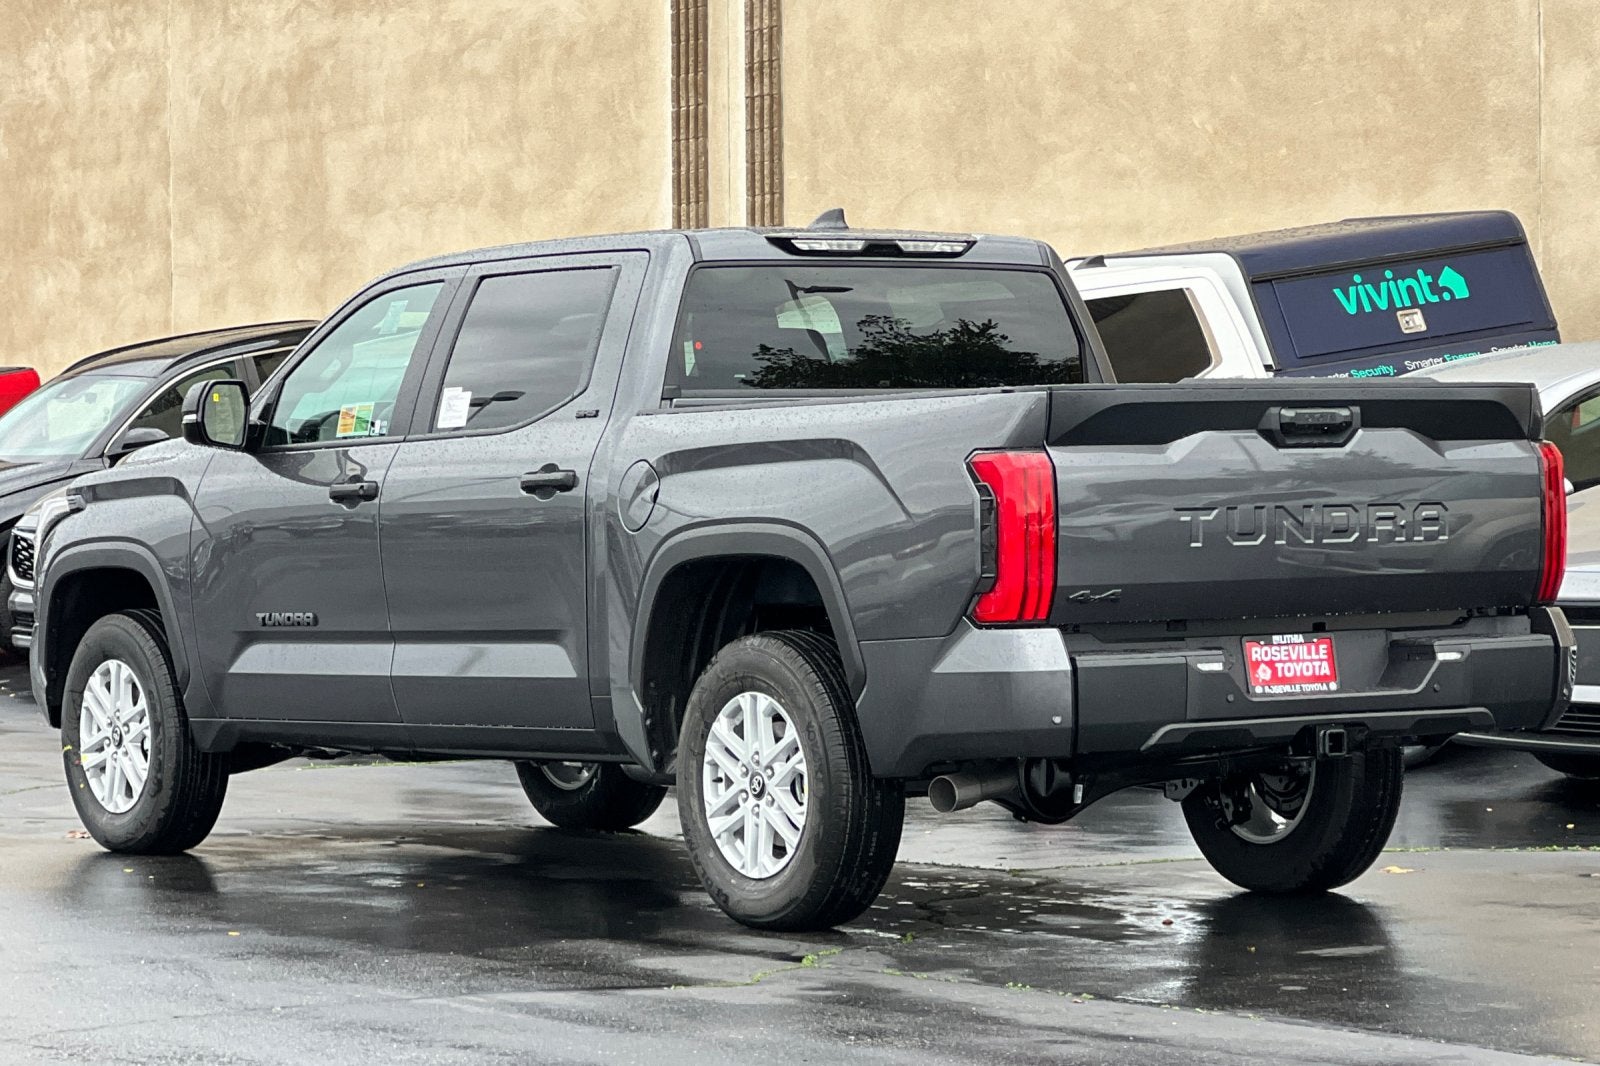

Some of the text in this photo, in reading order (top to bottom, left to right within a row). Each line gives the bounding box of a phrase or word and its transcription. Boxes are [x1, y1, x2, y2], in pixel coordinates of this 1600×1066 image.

[1350, 365, 1397, 378] Security.
[1404, 357, 1444, 371] Smarter
[1174, 502, 1449, 547] TUNDRA
[255, 612, 314, 627] TUNDRA
[1251, 644, 1328, 662] ROSEVILLE
[1275, 661, 1330, 677] TOYOTA
